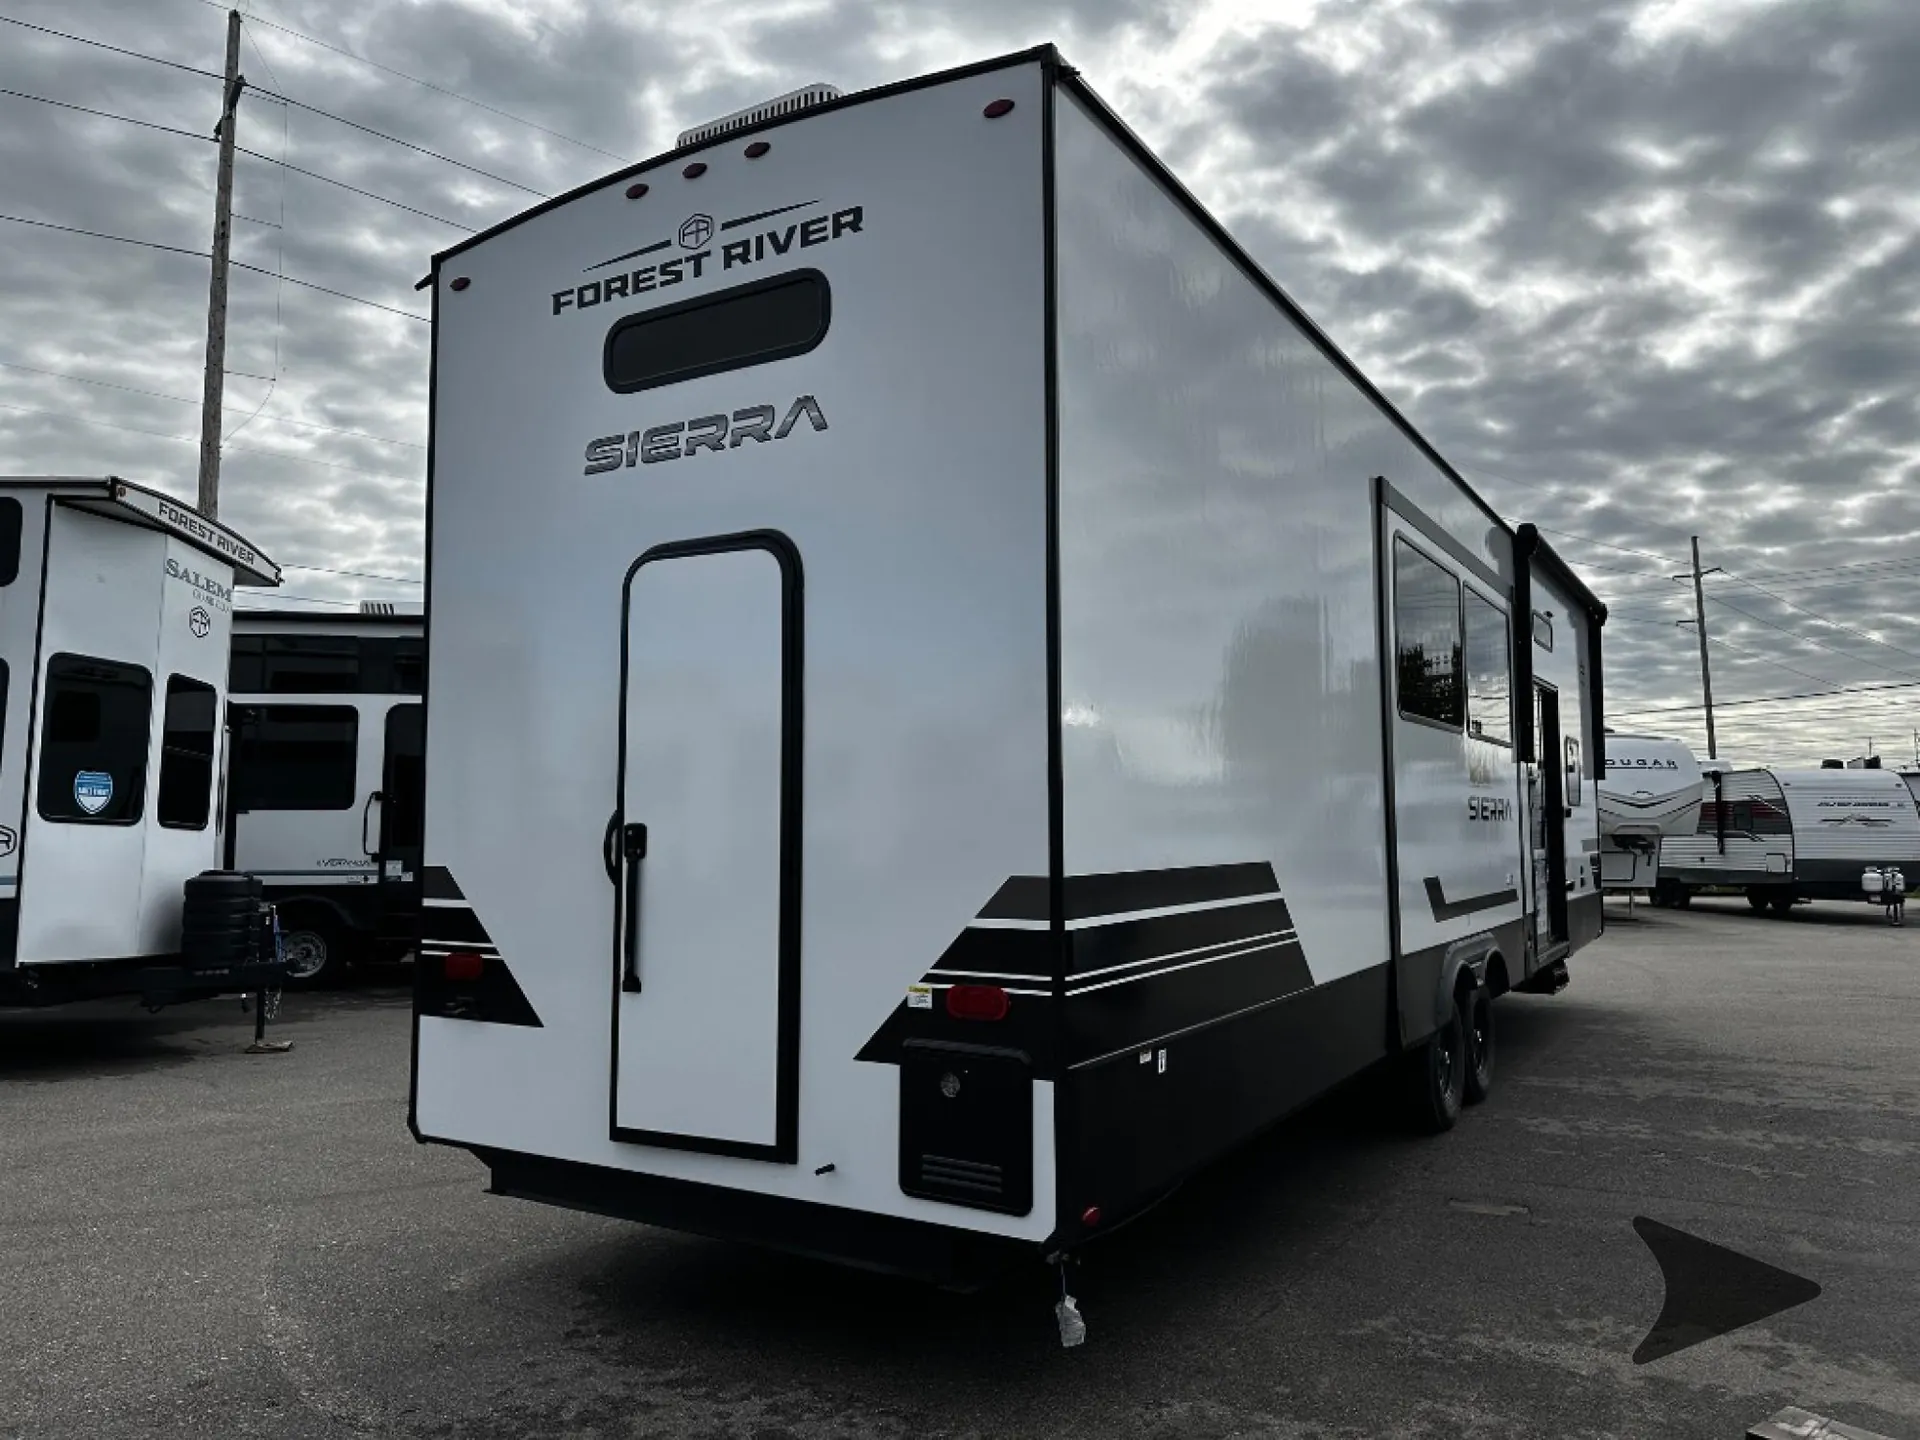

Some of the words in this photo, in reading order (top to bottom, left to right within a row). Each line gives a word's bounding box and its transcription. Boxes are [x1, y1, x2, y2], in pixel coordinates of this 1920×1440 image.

[551, 250, 712, 316] FOREST
[721, 205, 864, 271] RIVER
[584, 395, 829, 477] SIERRA
[158, 501, 216, 543] FOREST
[216, 535, 255, 566] RIVER
[165, 557, 233, 603] SALEM
[1605, 758, 1677, 768] OUGAR
[1467, 796, 1512, 821] SIERRA
